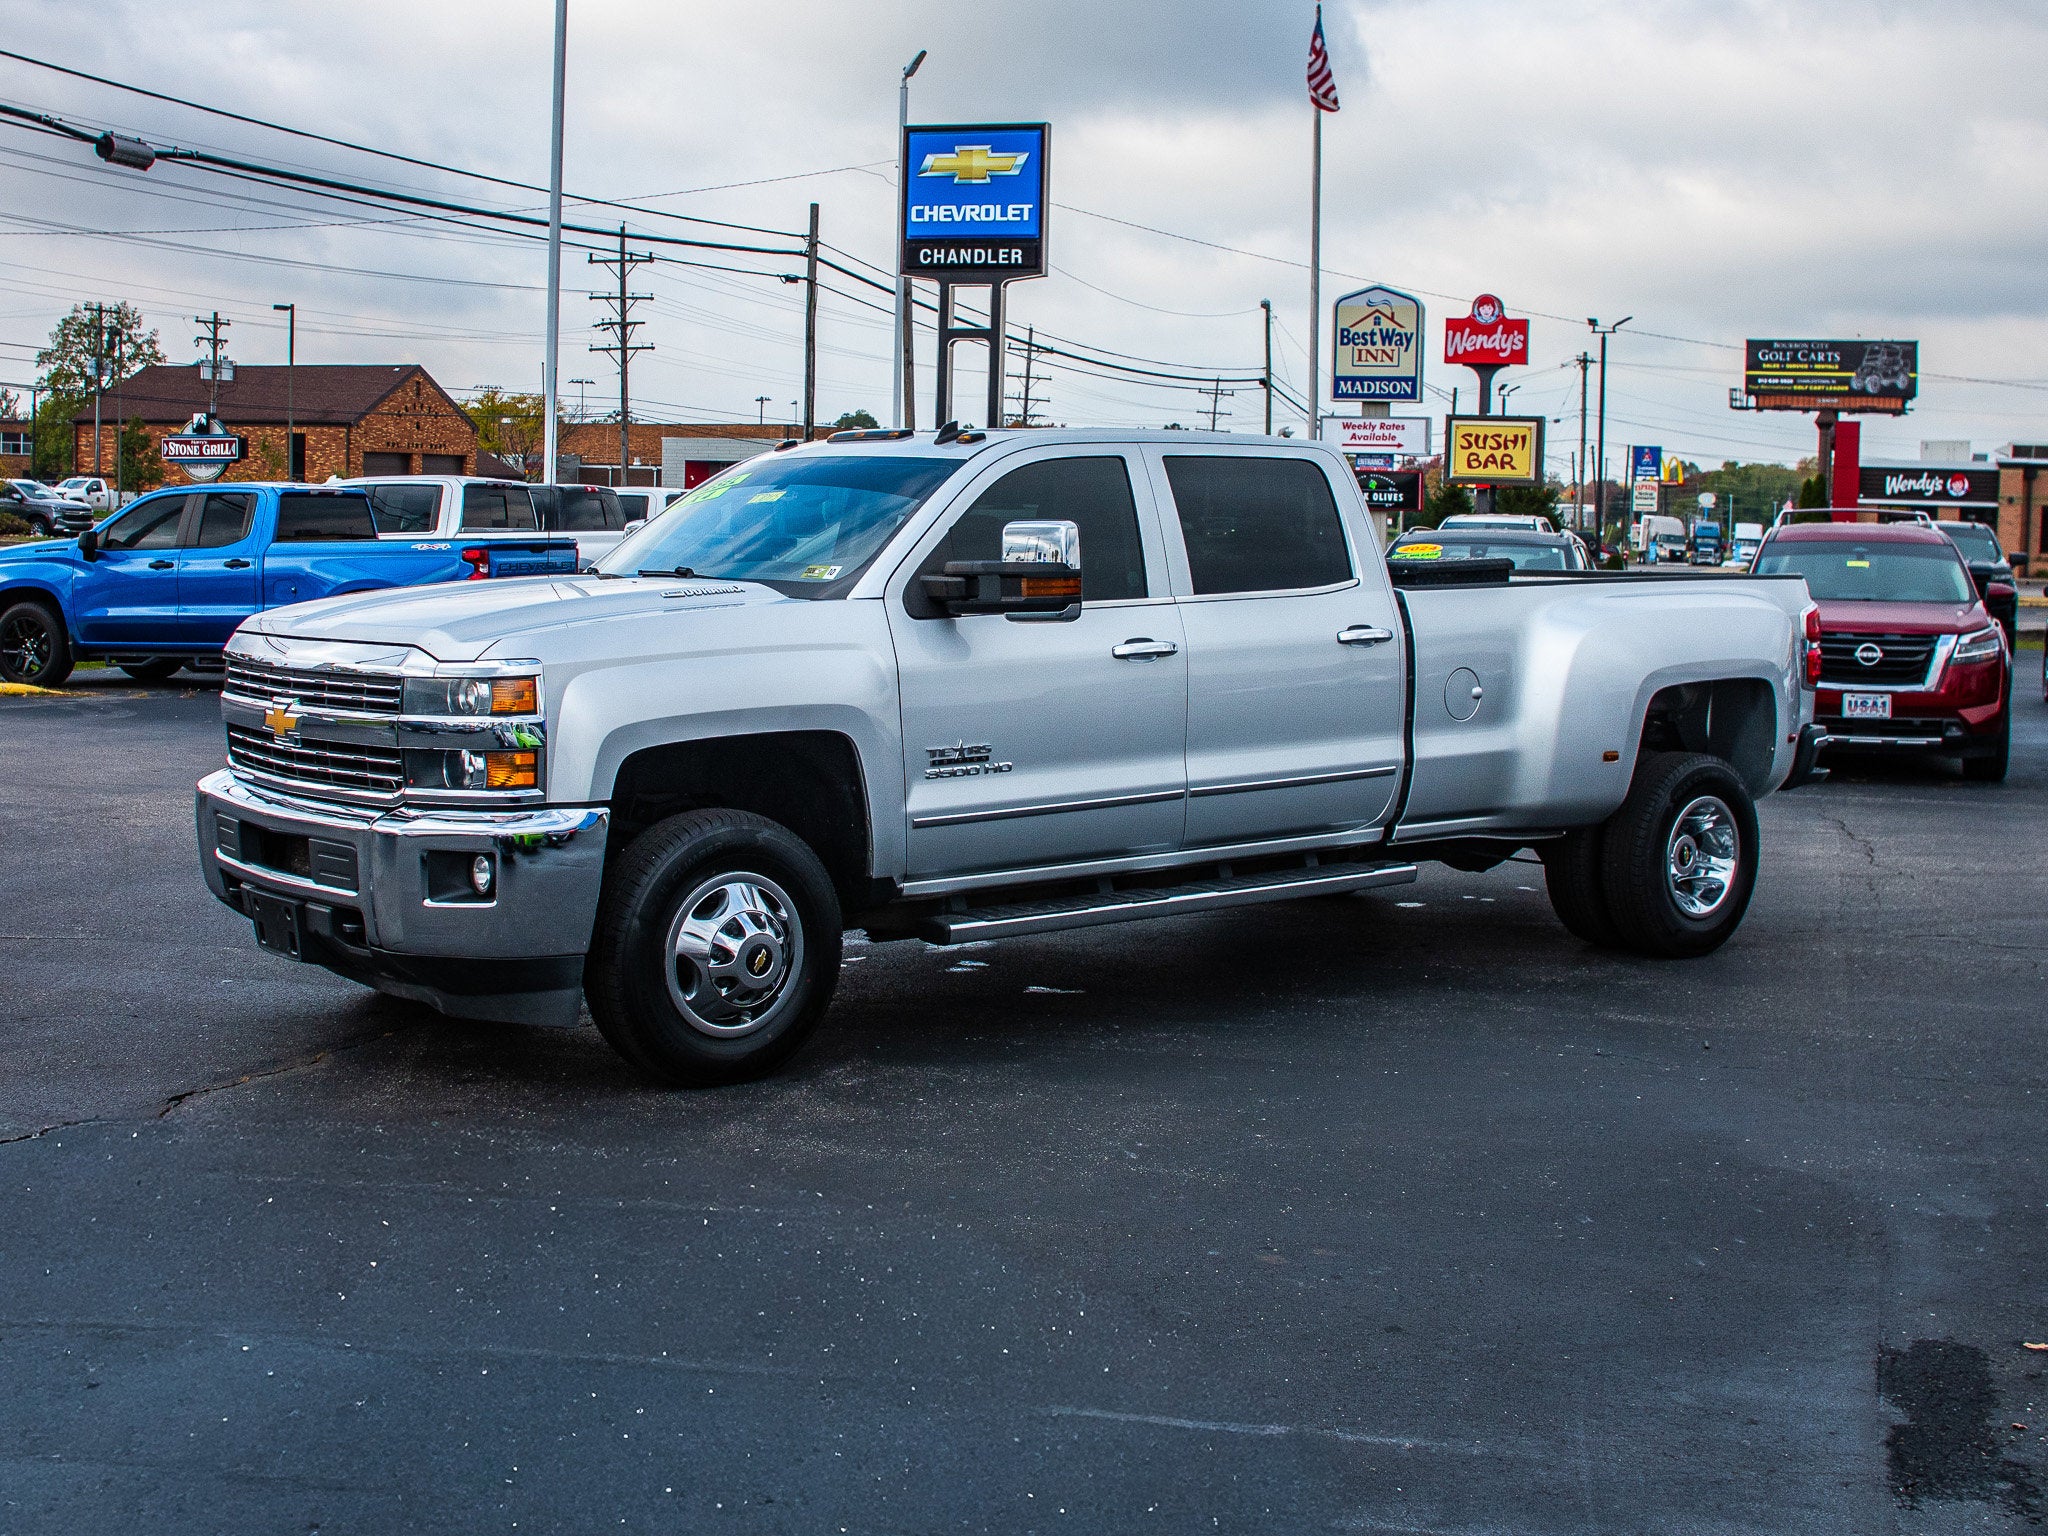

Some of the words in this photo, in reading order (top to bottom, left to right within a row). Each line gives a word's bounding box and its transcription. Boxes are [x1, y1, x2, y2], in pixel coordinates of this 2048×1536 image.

[911, 204, 1033, 222] CHEVROLET
[919, 248, 1023, 264] CHANDLER
[1447, 325, 1524, 357] Wendy's
[1356, 349, 1396, 363] INN
[1758, 349, 1794, 361] GOLF
[1797, 349, 1841, 362] CARTS
[1338, 380, 1413, 395] MADISON
[1342, 422, 1376, 433] Weekly
[1379, 422, 1406, 432] Rates
[1350, 432, 1397, 442] Available
[1460, 433, 1527, 451] SUSHI
[168, 441, 200, 456] STONE
[202, 443, 231, 456] GRILL
[1466, 453, 1517, 471] BAR
[1885, 472, 1944, 496] Wendy's
[1372, 492, 1404, 502] OLIVES
[499, 561, 575, 573] CHEVROLET
[1847, 700, 1888, 713] USA1
[984, 761, 1013, 775] HD
